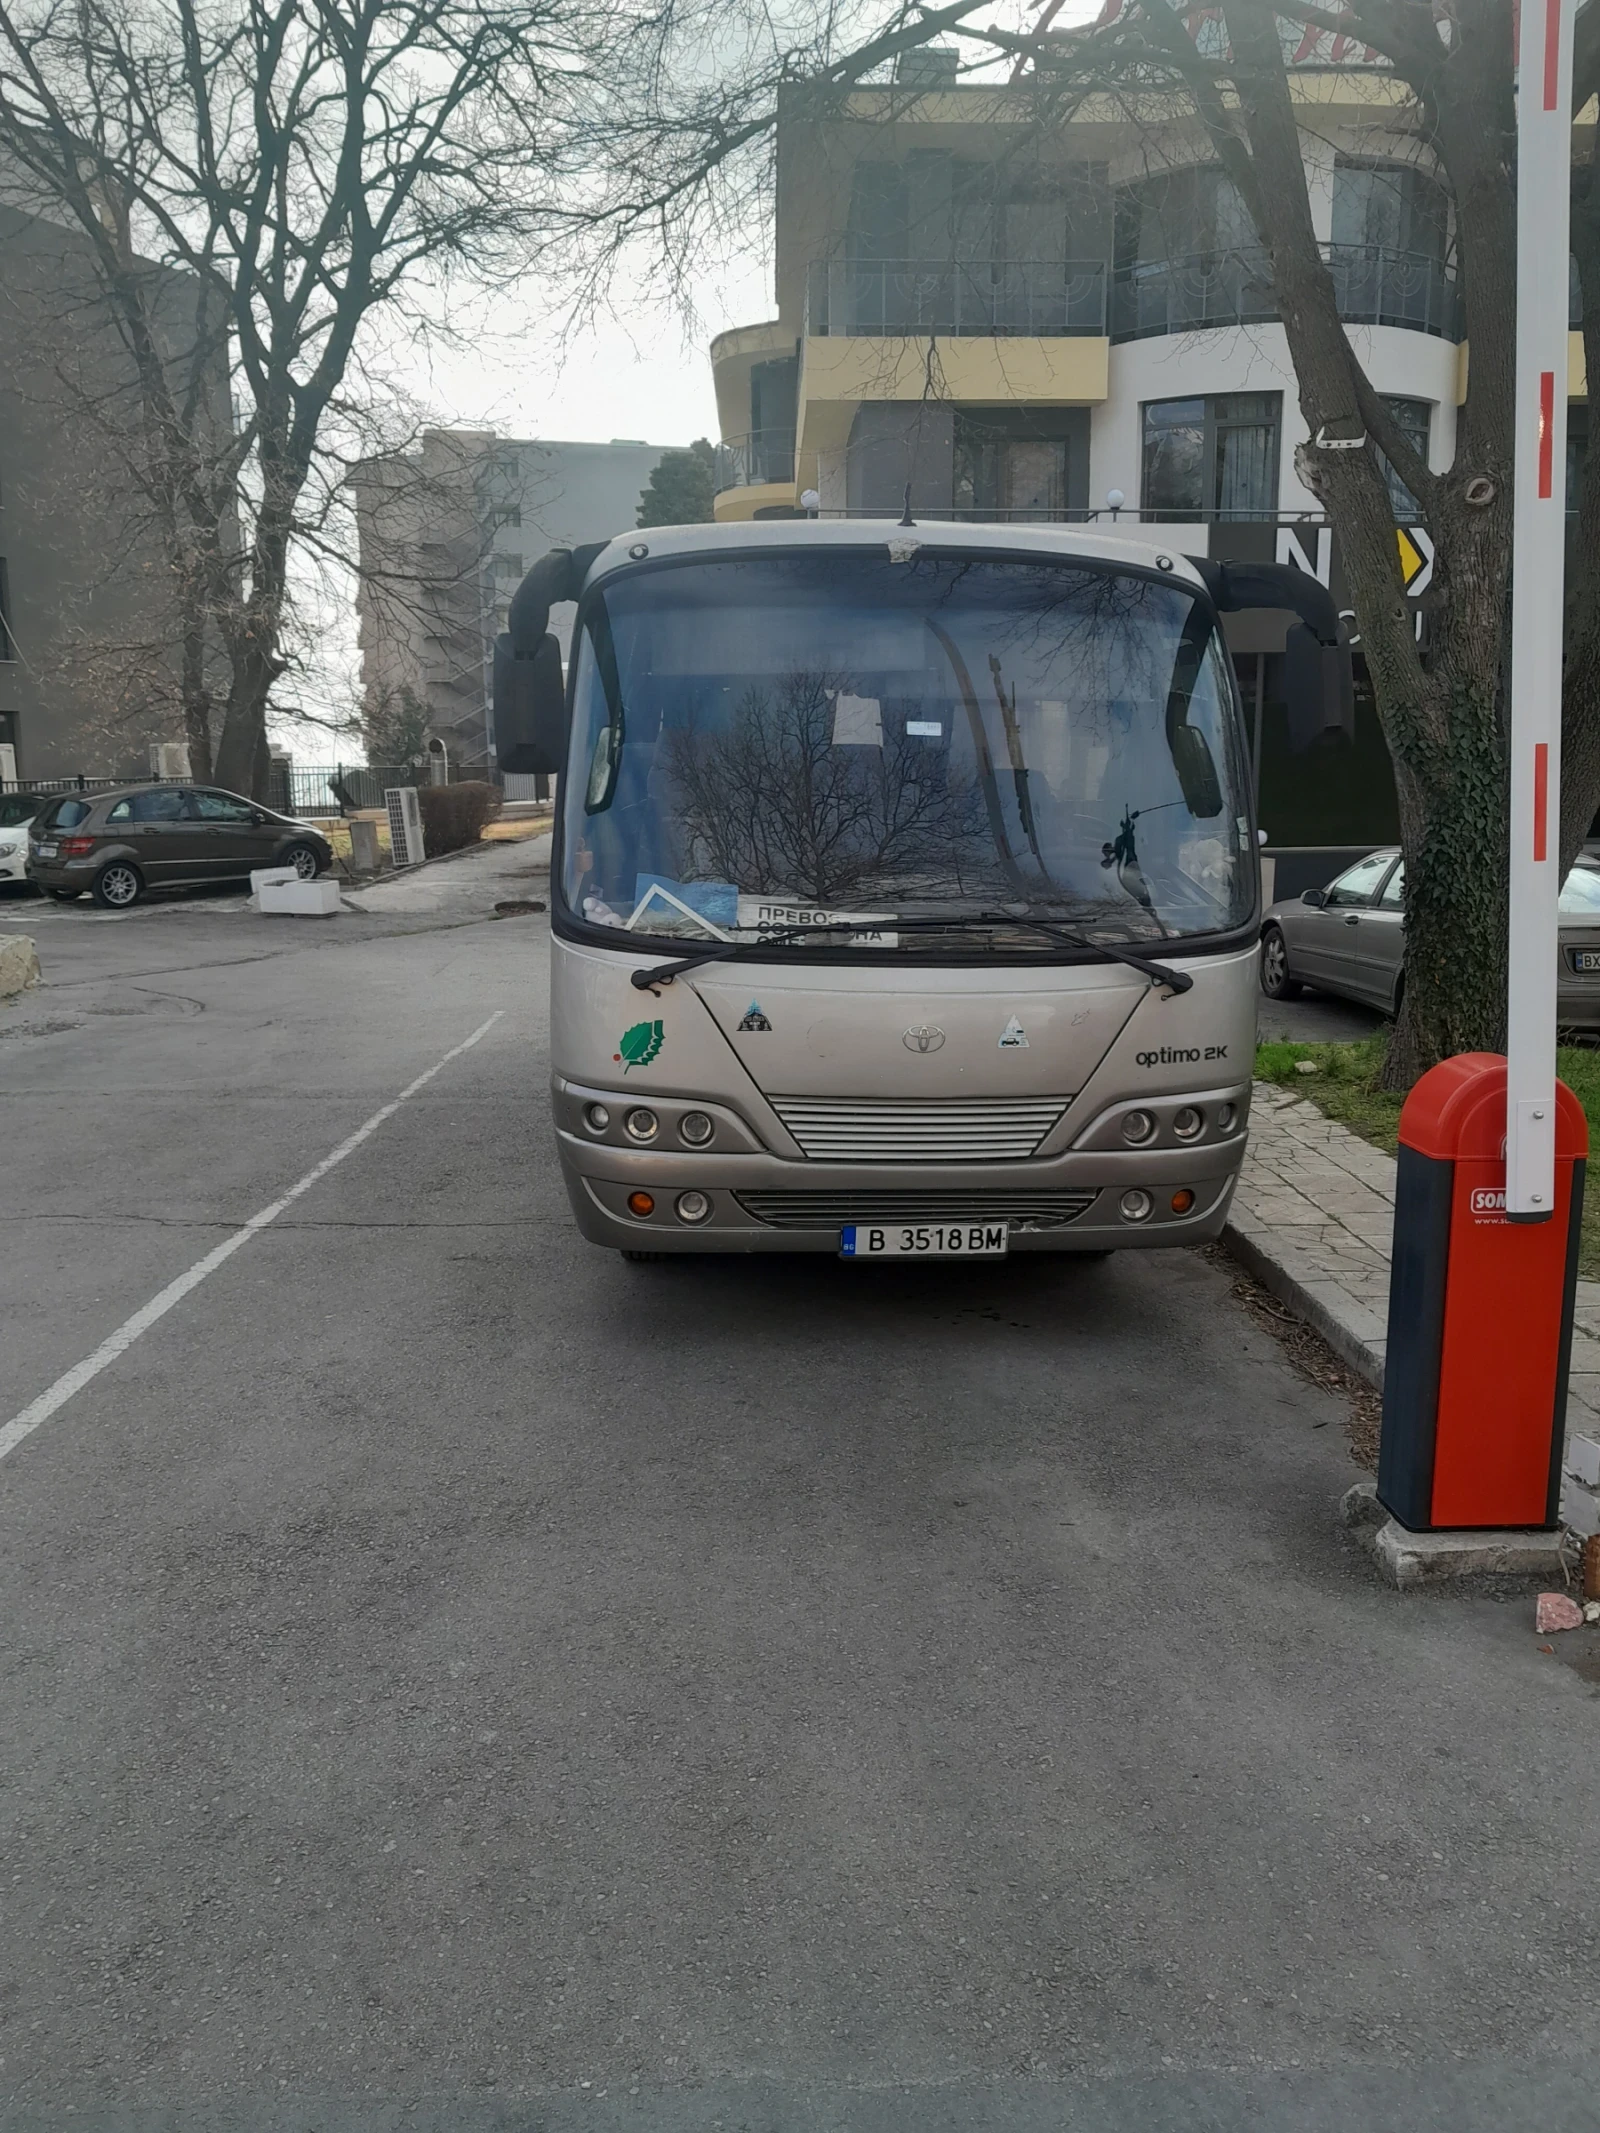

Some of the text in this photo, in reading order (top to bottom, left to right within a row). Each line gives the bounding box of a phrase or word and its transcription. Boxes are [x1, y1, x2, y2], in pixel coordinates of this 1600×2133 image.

[1135, 1045, 1229, 1069] optimo 2K
[869, 1227, 1003, 1251] B 3518 BM
